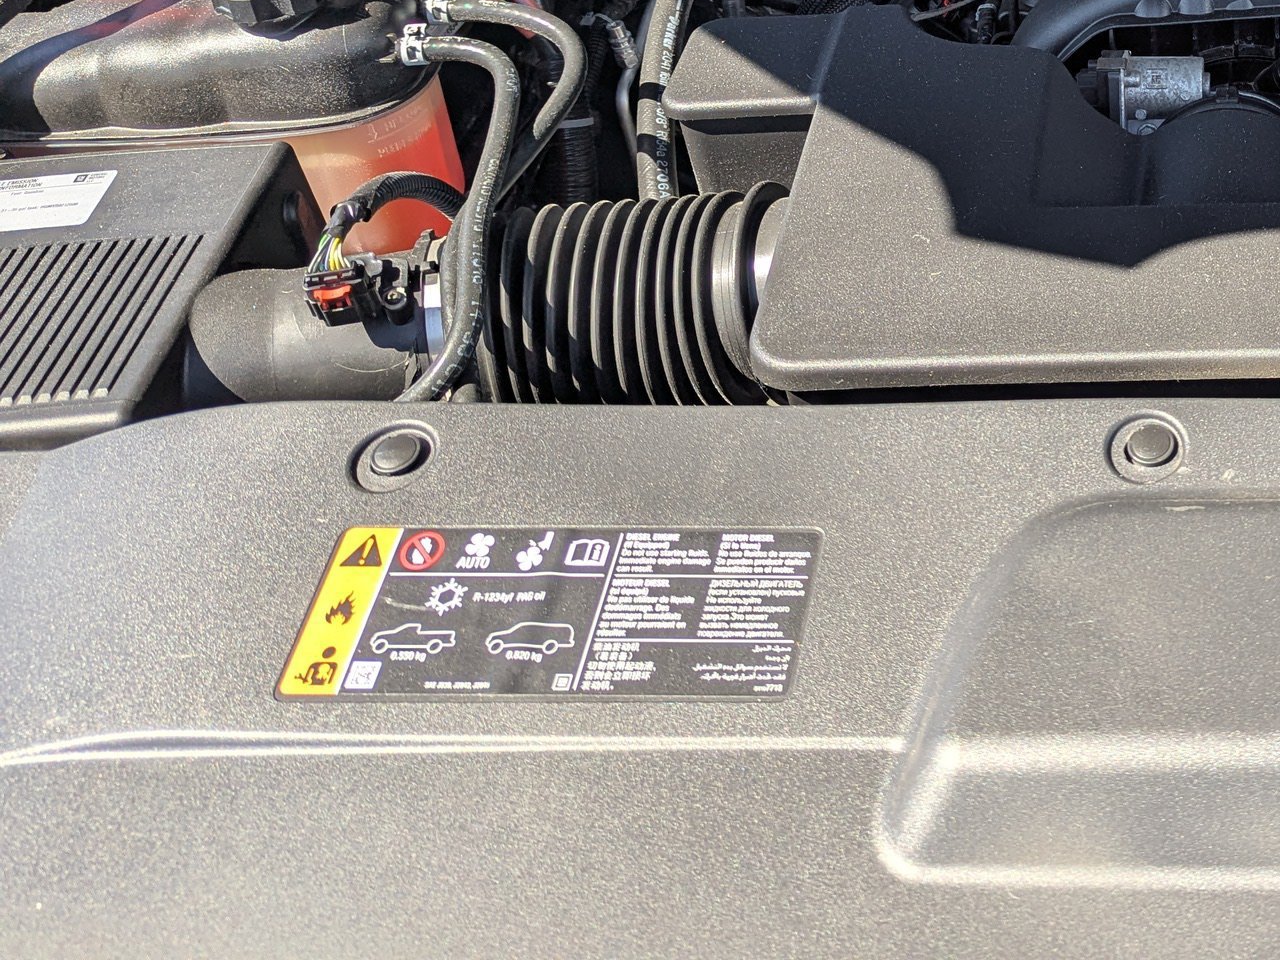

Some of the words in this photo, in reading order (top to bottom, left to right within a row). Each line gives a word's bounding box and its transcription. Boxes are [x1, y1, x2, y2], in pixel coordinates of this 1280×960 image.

[662, 15, 680, 50] Parker
[656, 159, 671, 199] 2706A
[456, 556, 490, 569] AUTO
[415, 651, 427, 662] kg
[530, 651, 543, 663] kg
